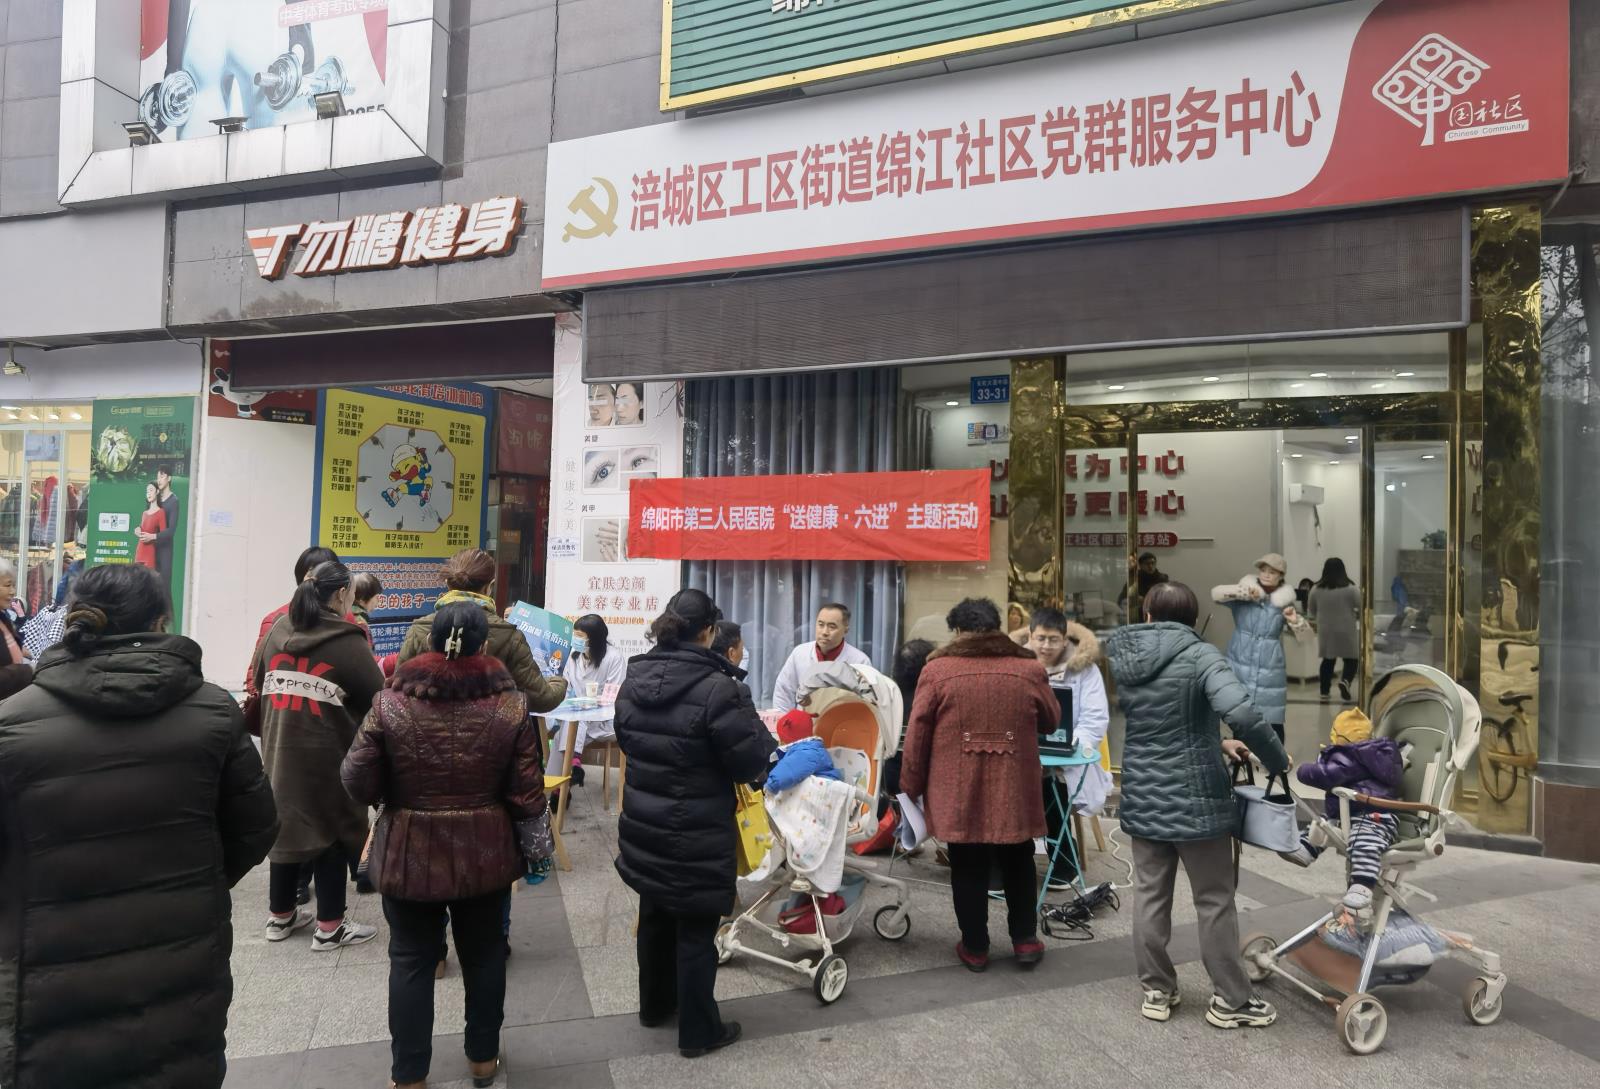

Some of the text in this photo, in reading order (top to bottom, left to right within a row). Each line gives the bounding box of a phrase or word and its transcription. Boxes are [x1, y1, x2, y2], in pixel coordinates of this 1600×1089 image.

[1448, 122, 1526, 140] Chinese Community
[629, 70, 1321, 232] 涪城区工区街道绵江社区党群服务中心
[977, 387, 1006, 400] 33-31
[375, 593, 447, 610] 您的孩子一
[578, 596, 659, 611] 美容专业店
[286, 680, 336, 699] pretty
